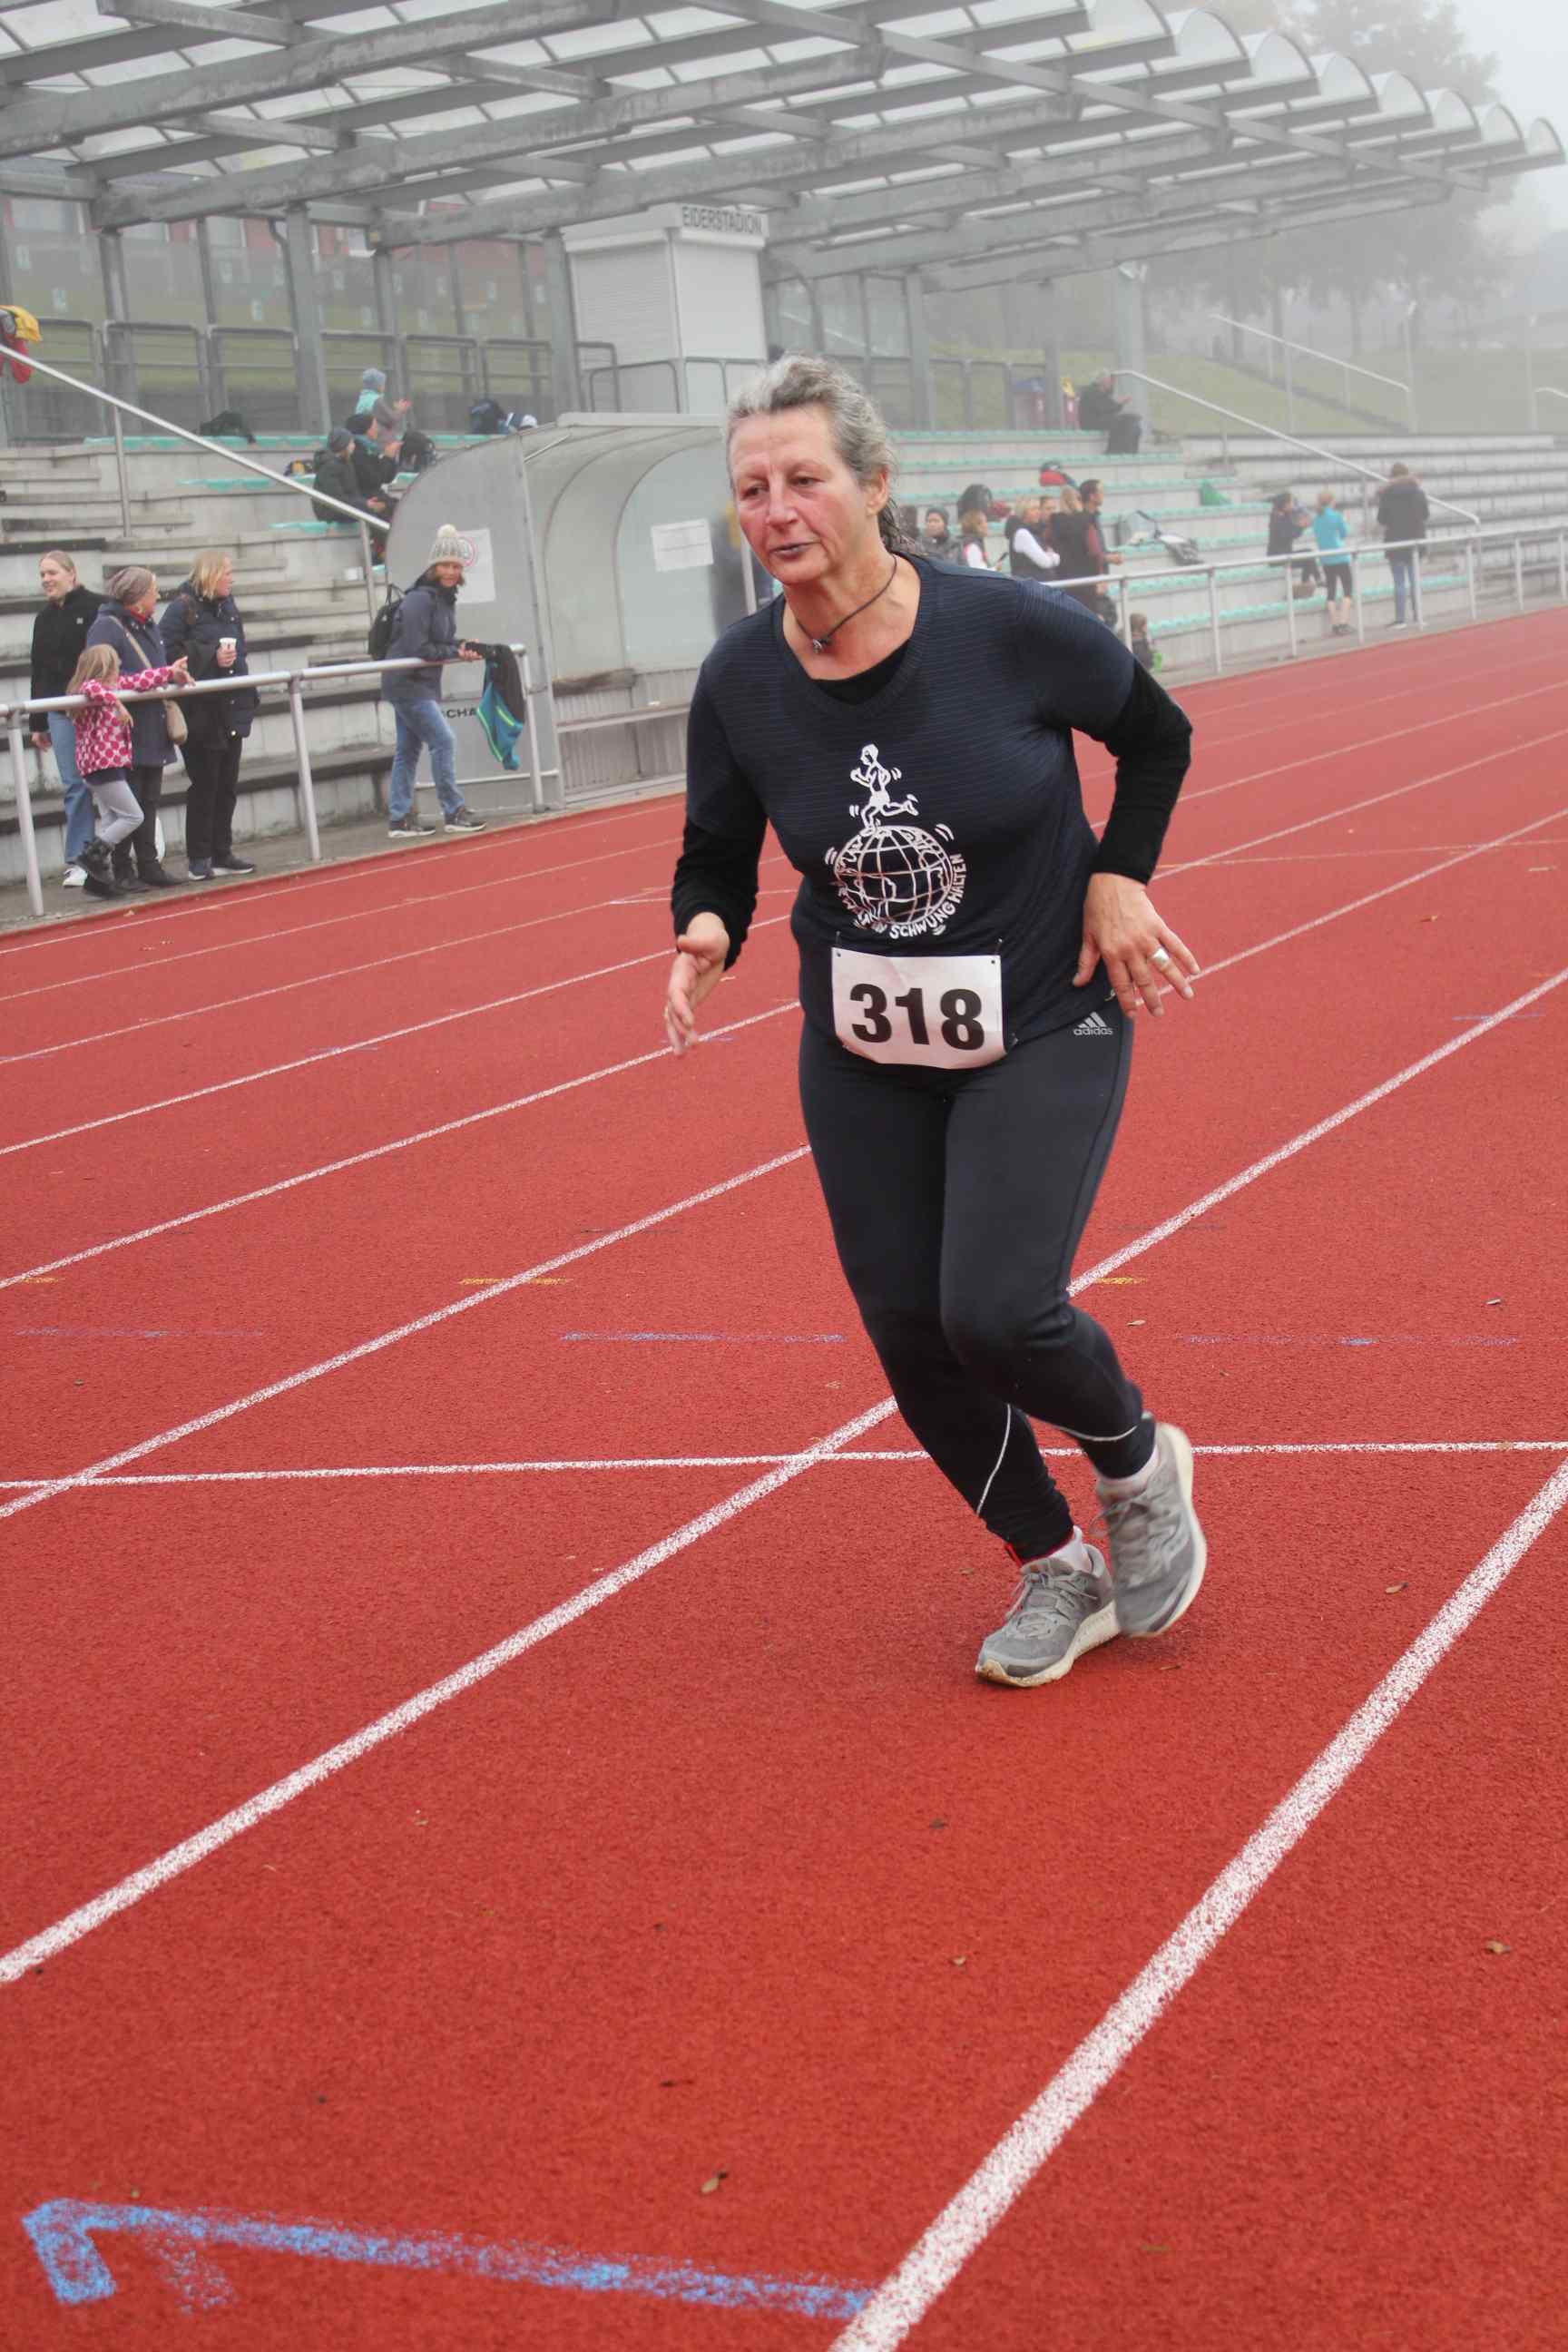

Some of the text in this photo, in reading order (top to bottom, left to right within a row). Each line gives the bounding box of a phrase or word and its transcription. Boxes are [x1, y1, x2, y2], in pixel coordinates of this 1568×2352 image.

[682, 206, 761, 233] EIDERSTADION
[889, 854, 966, 939] SCHWUNG HALTEN
[849, 983, 985, 1051] 318
[1073, 1026, 1112, 1035] adidas
